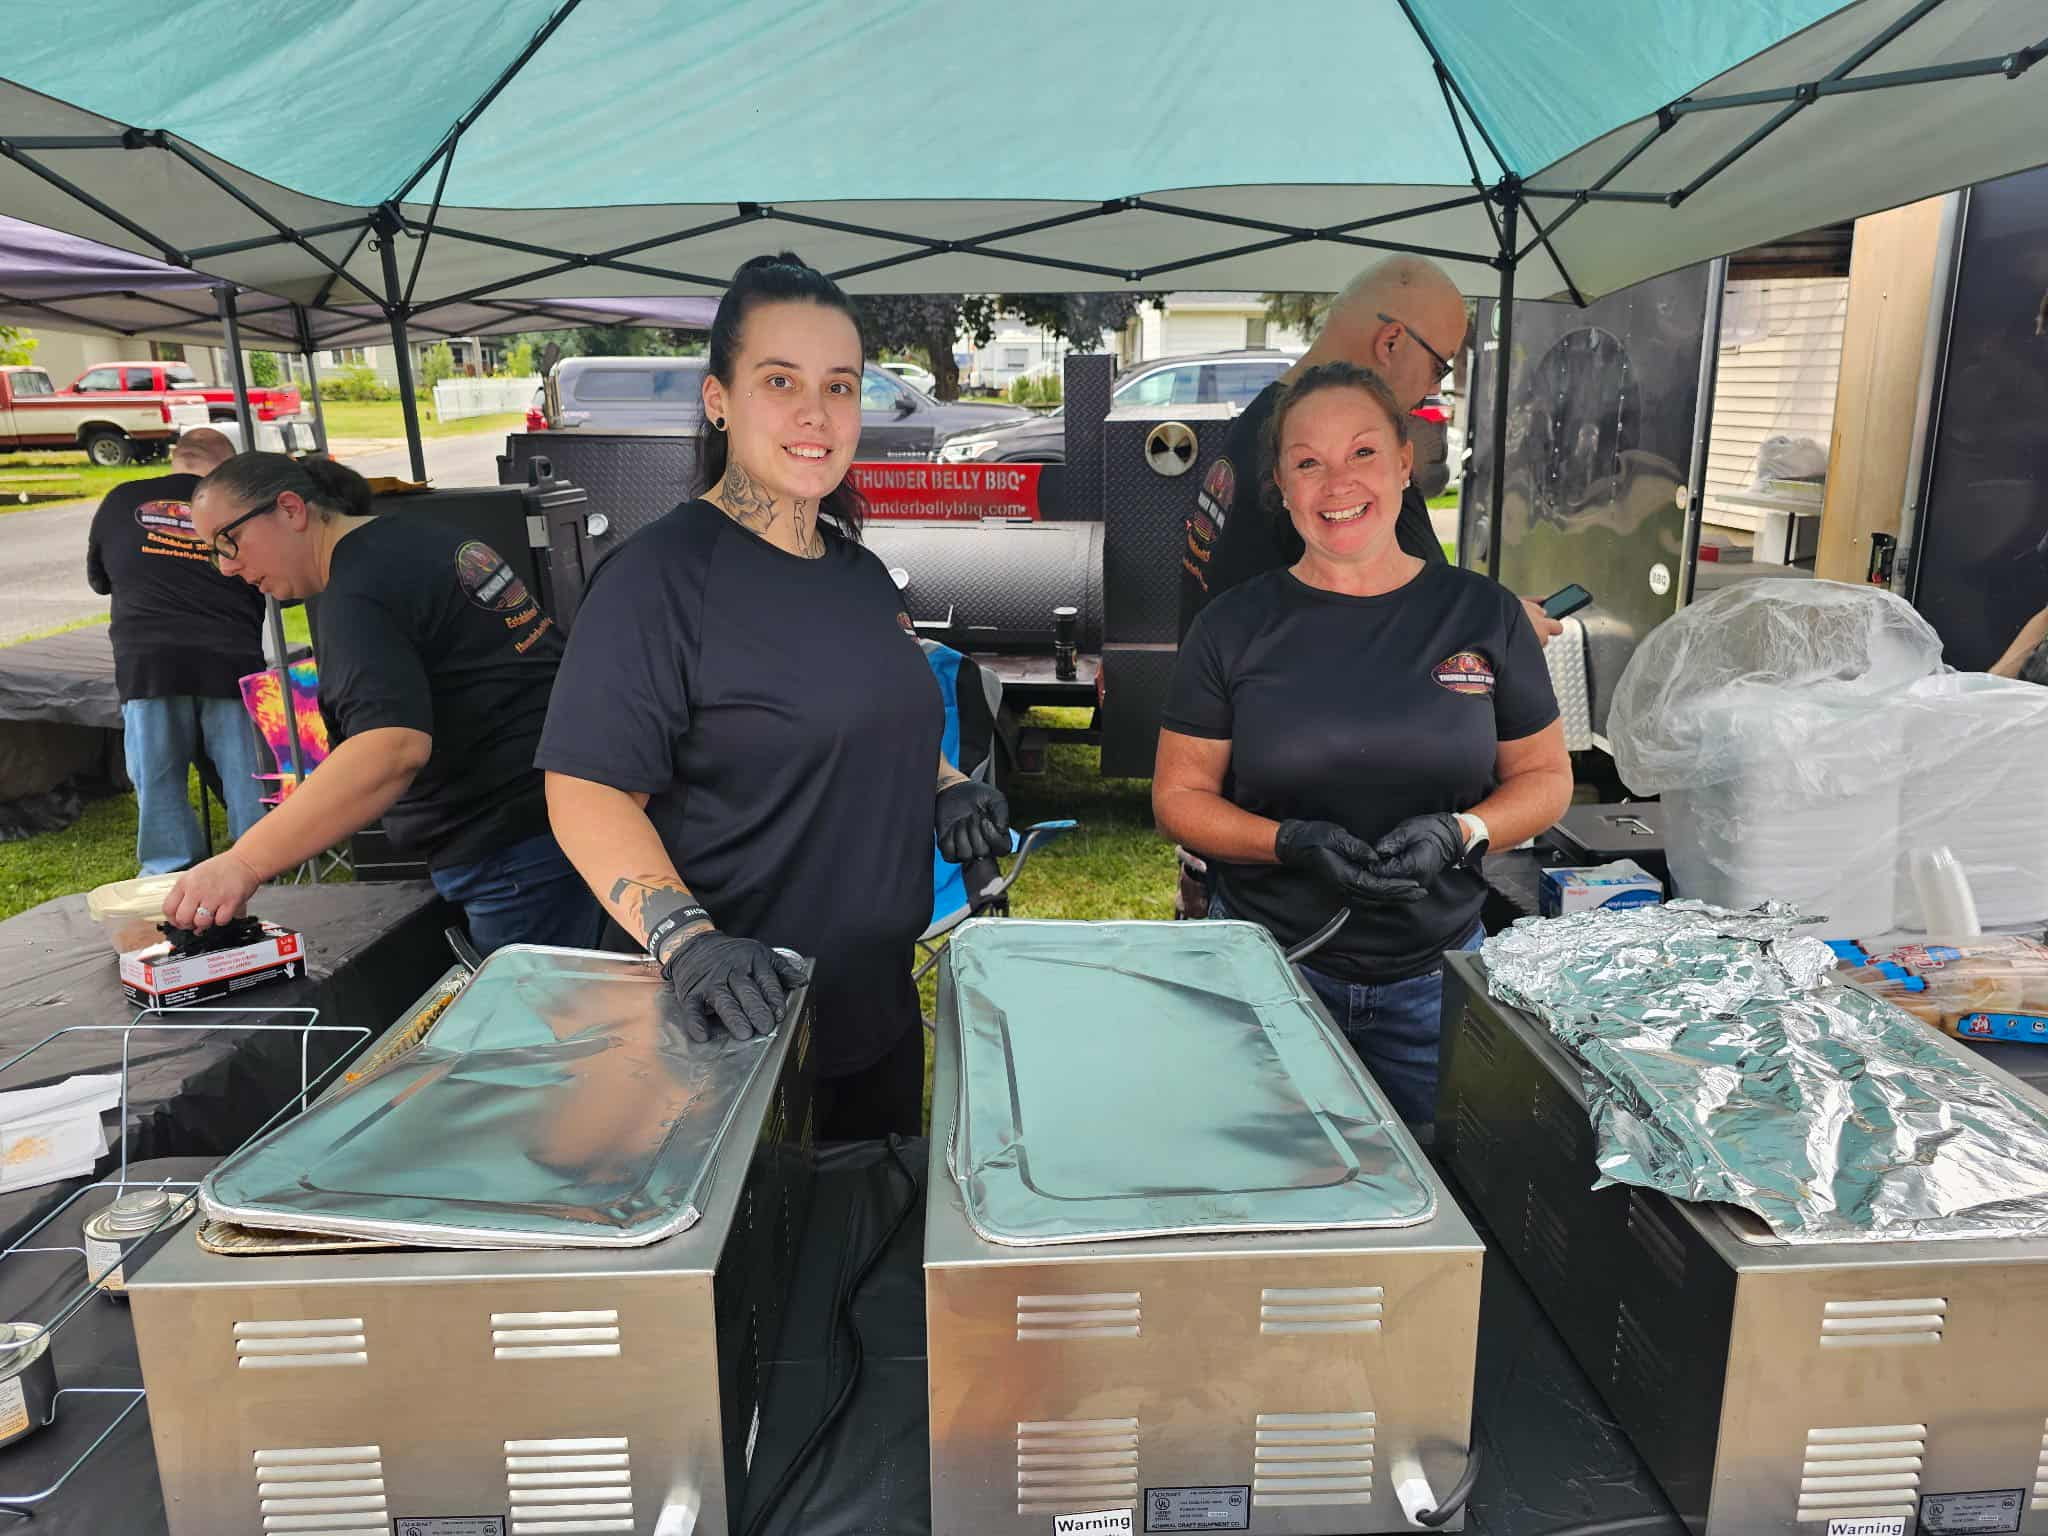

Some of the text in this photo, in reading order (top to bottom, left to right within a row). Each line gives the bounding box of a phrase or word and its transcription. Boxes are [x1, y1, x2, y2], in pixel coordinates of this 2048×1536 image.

[853, 469, 1020, 491] THUNDER BELLY BBQ
[858, 499, 1021, 518] underbellybbq.com
[1058, 1516, 1130, 1532] Warning
[1832, 1522, 1902, 1536] Warning
